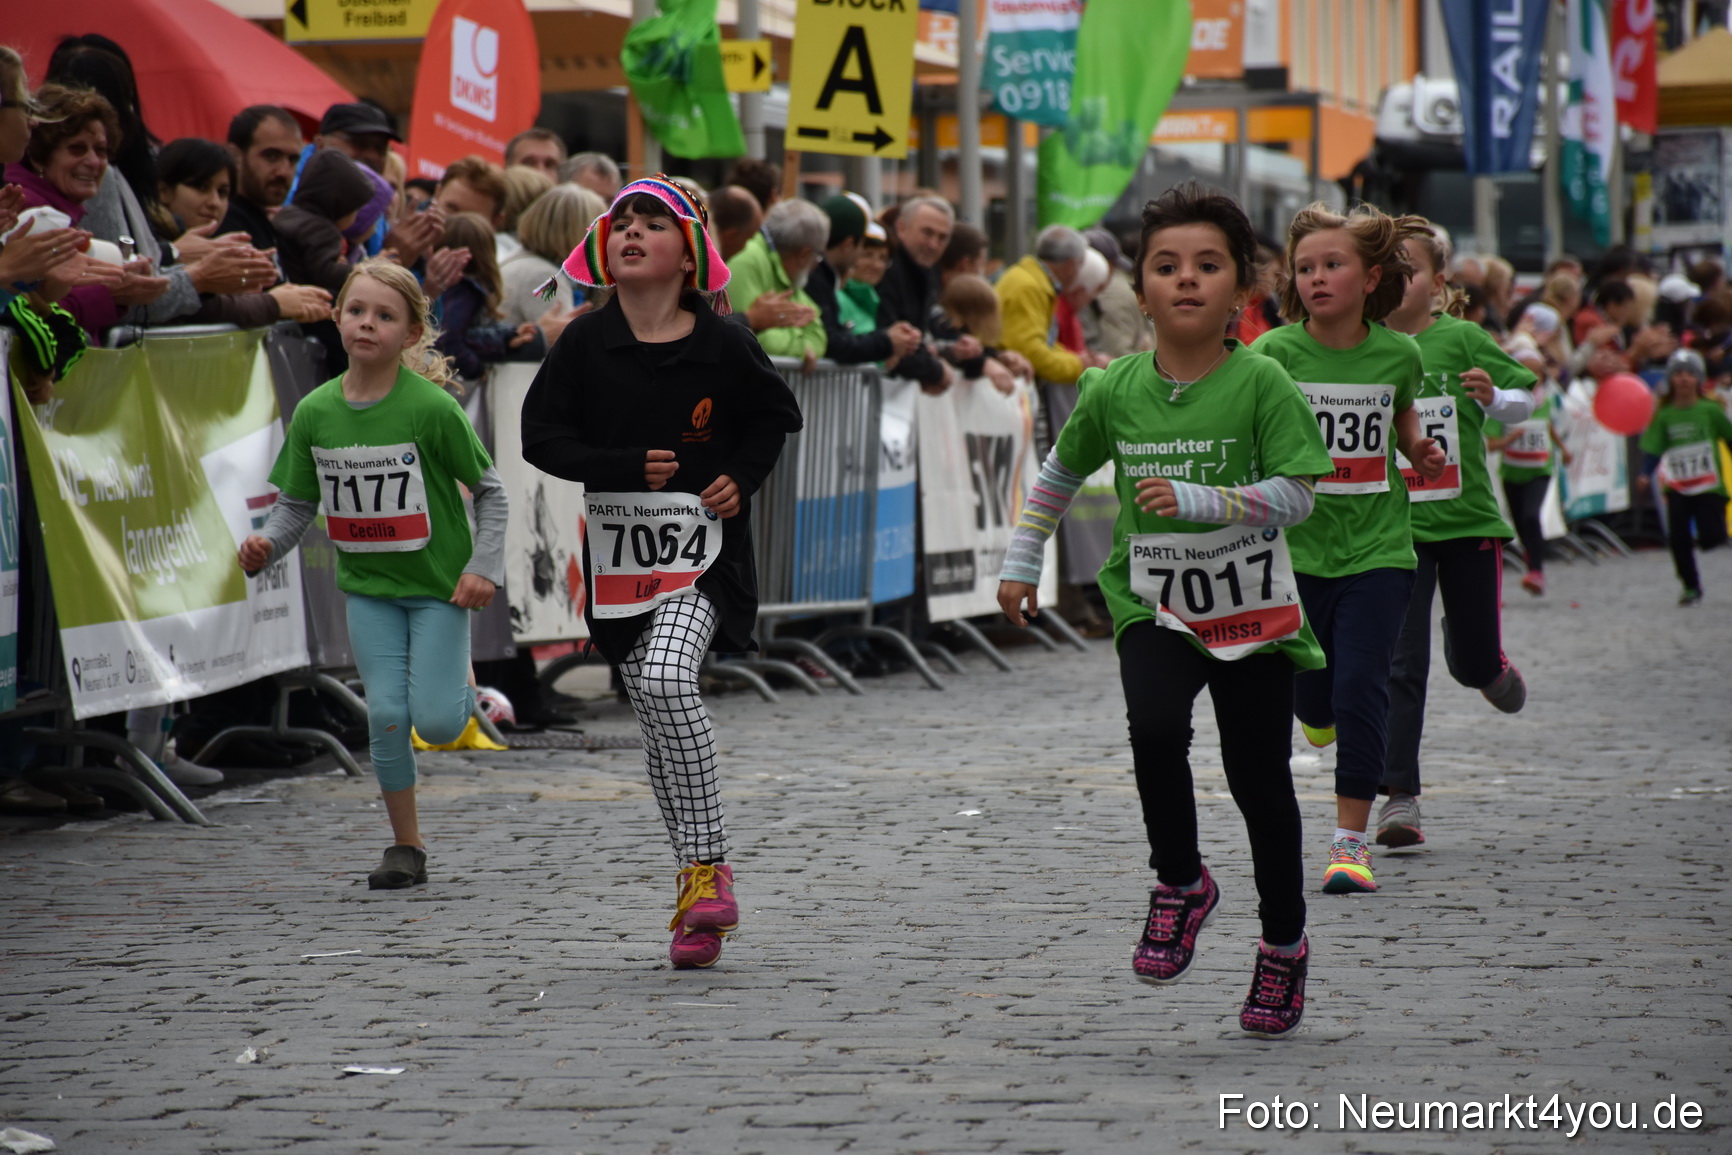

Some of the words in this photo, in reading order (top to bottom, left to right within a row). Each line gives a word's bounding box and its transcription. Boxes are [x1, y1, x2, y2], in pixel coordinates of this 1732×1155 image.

[343, 10, 407, 27] Freibad
[815, 25, 884, 116] A
[1320, 395, 1377, 406] Neumarkt
[1116, 438, 1214, 455] Neumarkter
[317, 457, 342, 470] PARTL
[344, 457, 398, 470] Neumarkt
[324, 471, 410, 512] 7177
[588, 504, 631, 517] PARTL
[634, 504, 700, 517] Neumarkt
[349, 523, 396, 538] Cecilia
[602, 523, 708, 568] 7064
[1134, 545, 1182, 561] PARTL
[1185, 533, 1257, 560] Neumarkt
[1148, 549, 1274, 615] 7017
